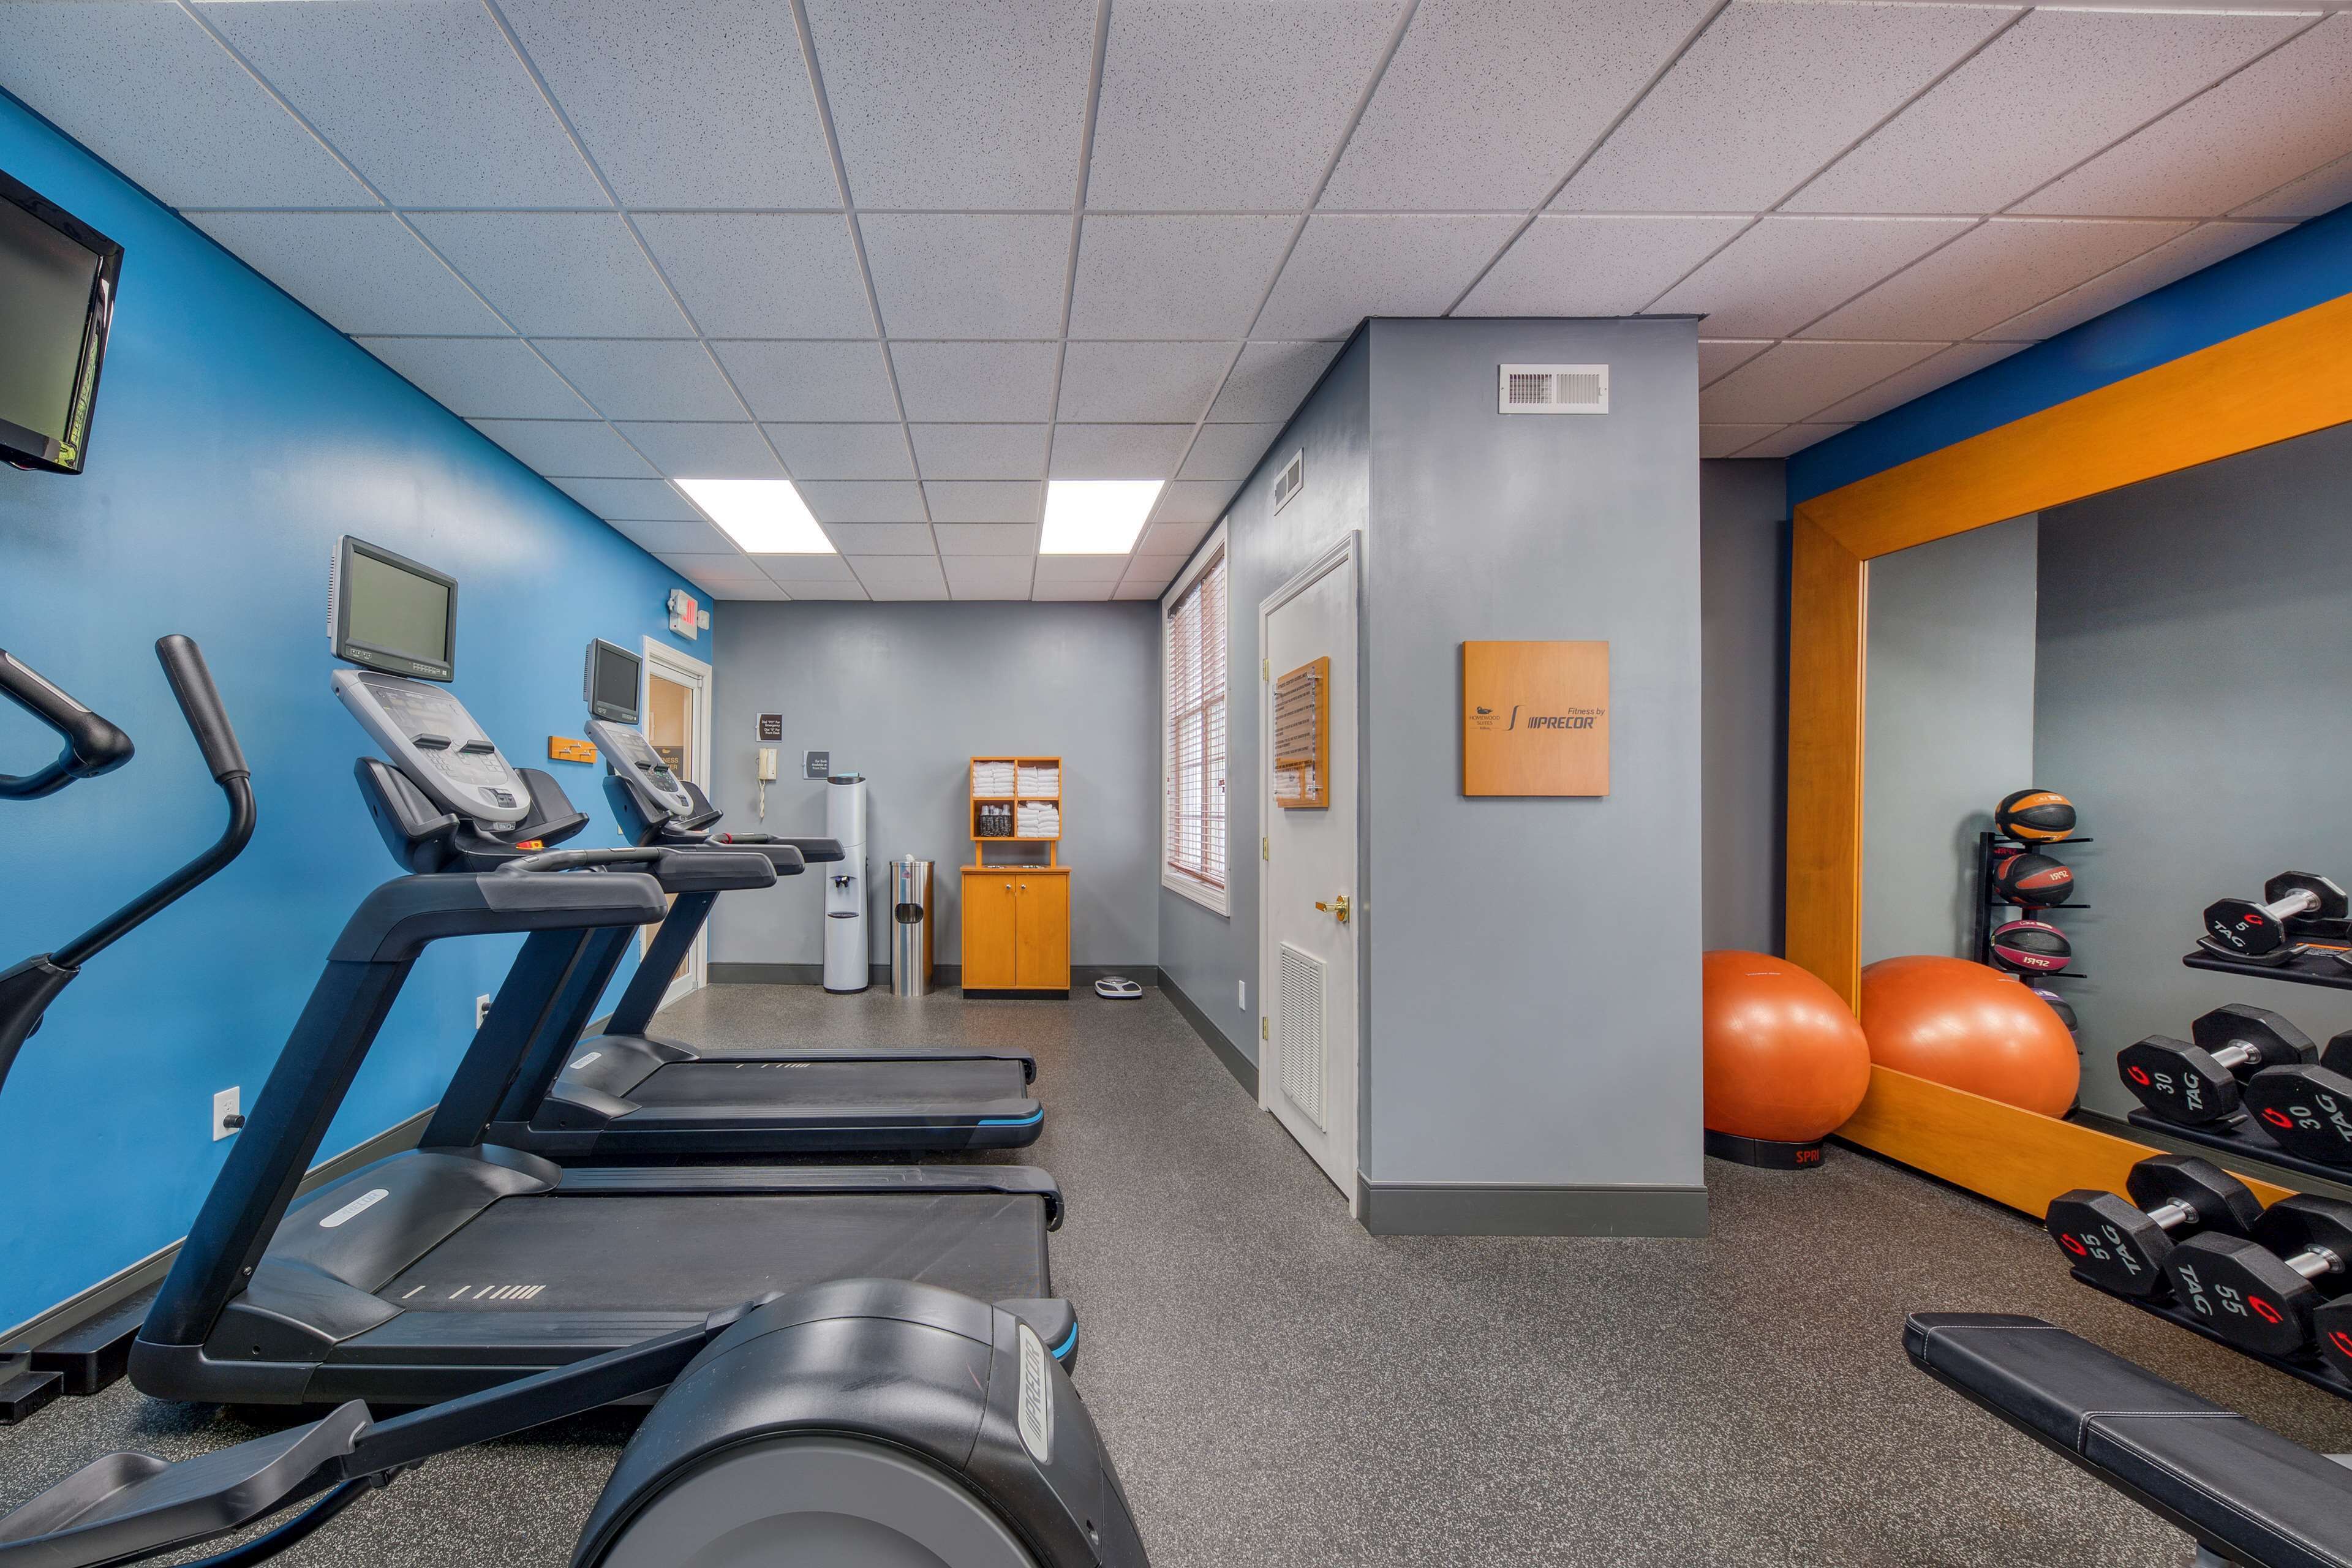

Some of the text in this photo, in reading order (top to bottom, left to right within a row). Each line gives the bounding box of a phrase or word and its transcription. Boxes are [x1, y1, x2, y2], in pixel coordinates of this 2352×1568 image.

[1536, 717, 1594, 728] PRECOR
[2214, 921, 2245, 948] TAG
[2236, 921, 2249, 930] 5
[2154, 1072, 2174, 1095] 30
[2184, 1072, 2203, 1110] TAG
[2290, 1106, 2321, 1129] 30
[1796, 1148, 1820, 1163] SPRI
[2080, 1234, 2110, 1260] 55
[2101, 1225, 2141, 1275] TAG
[2178, 1264, 2213, 1316] TAG
[2215, 1284, 2248, 1317] 55
[1025, 1338, 1042, 1428] PRECOR
